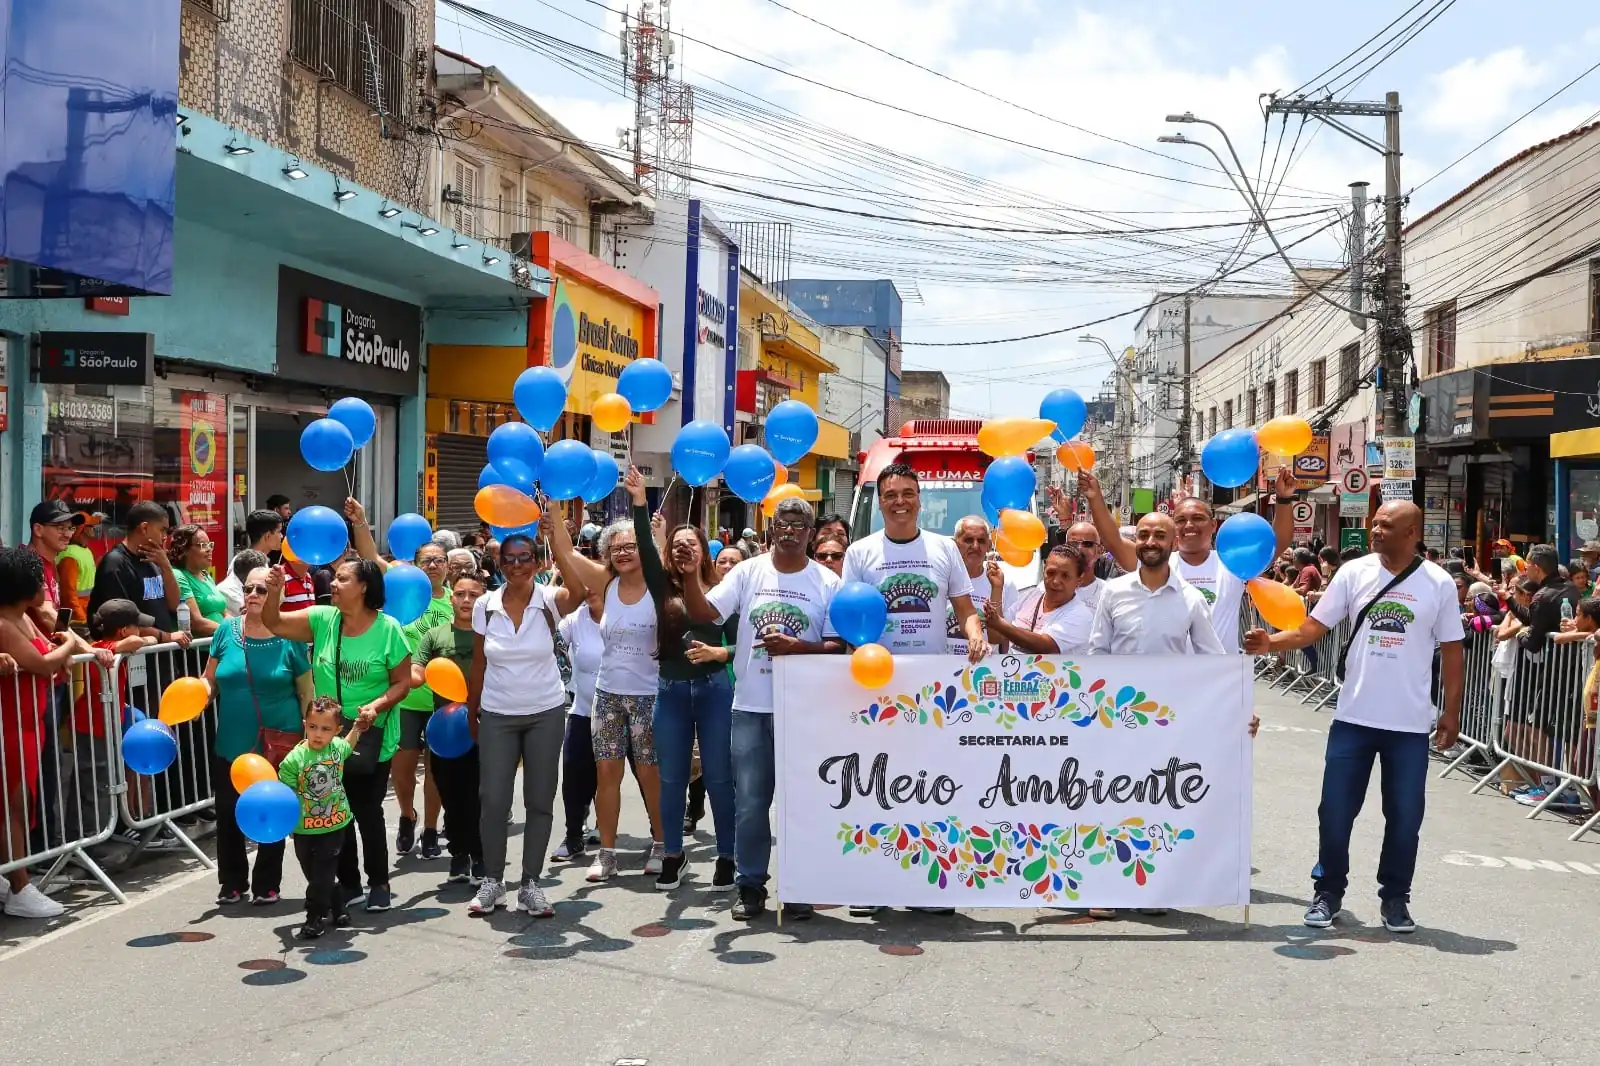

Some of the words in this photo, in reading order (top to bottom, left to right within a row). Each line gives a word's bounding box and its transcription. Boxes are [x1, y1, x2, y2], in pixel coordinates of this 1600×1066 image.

[347, 309, 376, 329] Drogaria
[579, 312, 609, 351] Brasil
[610, 325, 638, 361] Sorriso
[347, 328, 409, 372] SãoPaulo
[79, 356, 138, 368] SãoPaulo
[581, 353, 605, 375] Clínicas
[1350, 473, 1360, 489] E
[1297, 506, 1306, 518] E
[1003, 679, 1039, 693] FERRAZ
[958, 735, 1046, 747] SECRETARIA
[1049, 735, 1069, 747] DE
[817, 751, 962, 810] Meio
[978, 752, 1210, 811] Ambiente
[304, 810, 347, 829] ROCKY
